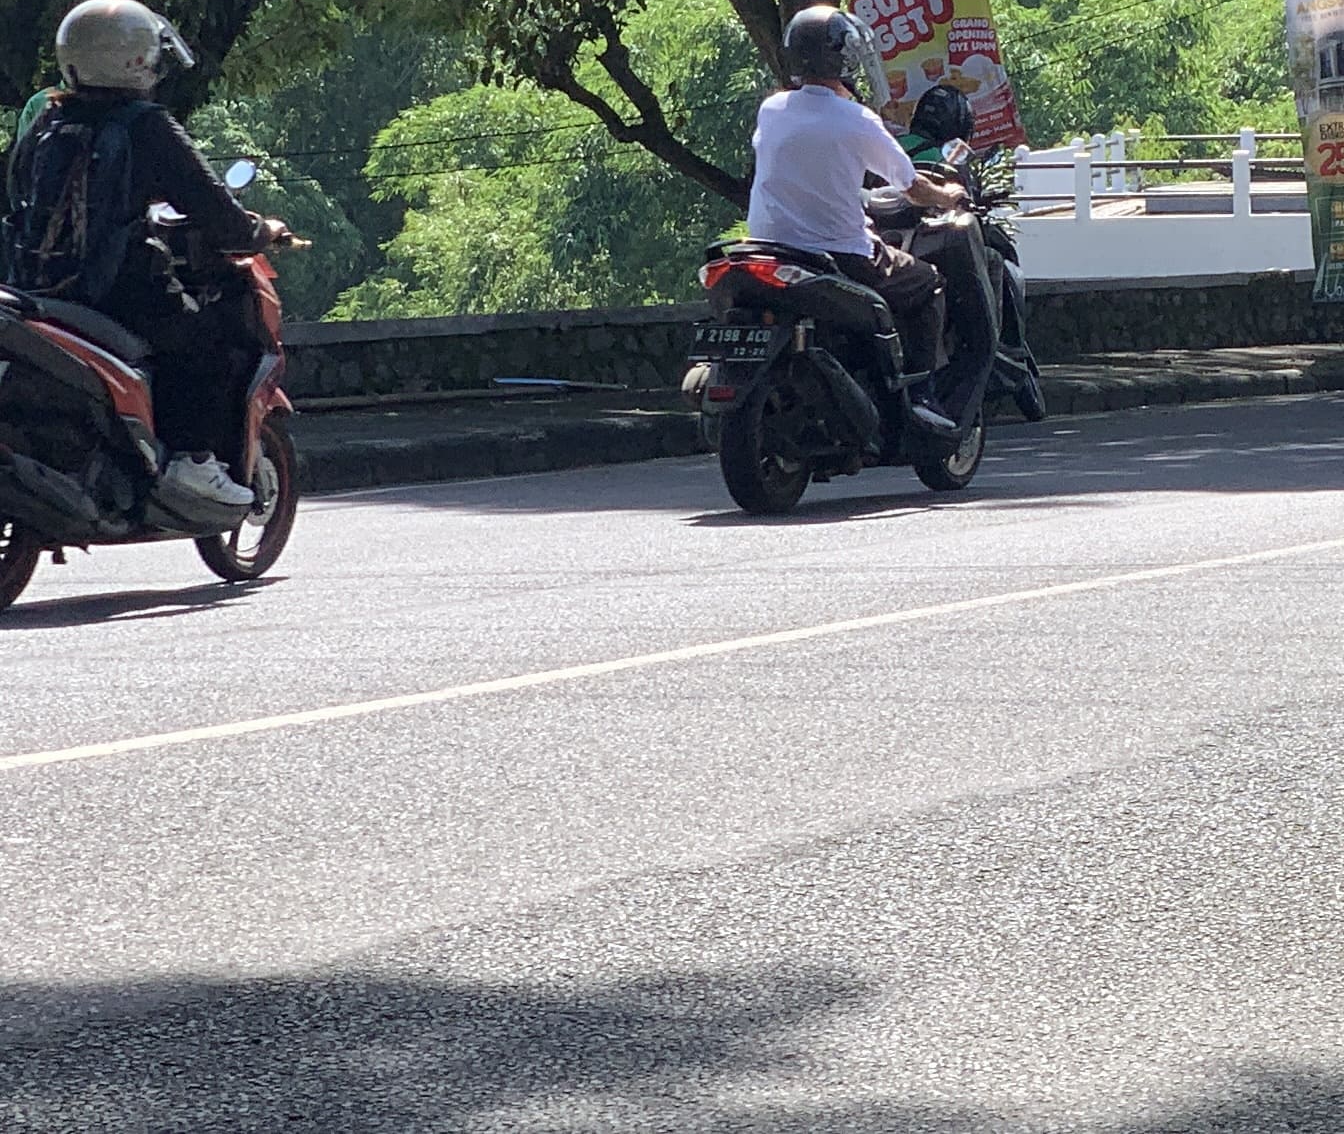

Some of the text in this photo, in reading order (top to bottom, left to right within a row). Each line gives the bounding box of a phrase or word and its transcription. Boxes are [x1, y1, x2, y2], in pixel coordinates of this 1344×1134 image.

[873, 6, 929, 52] GET
[953, 19, 988, 28] GRAND
[948, 30, 995, 41] OPENING
